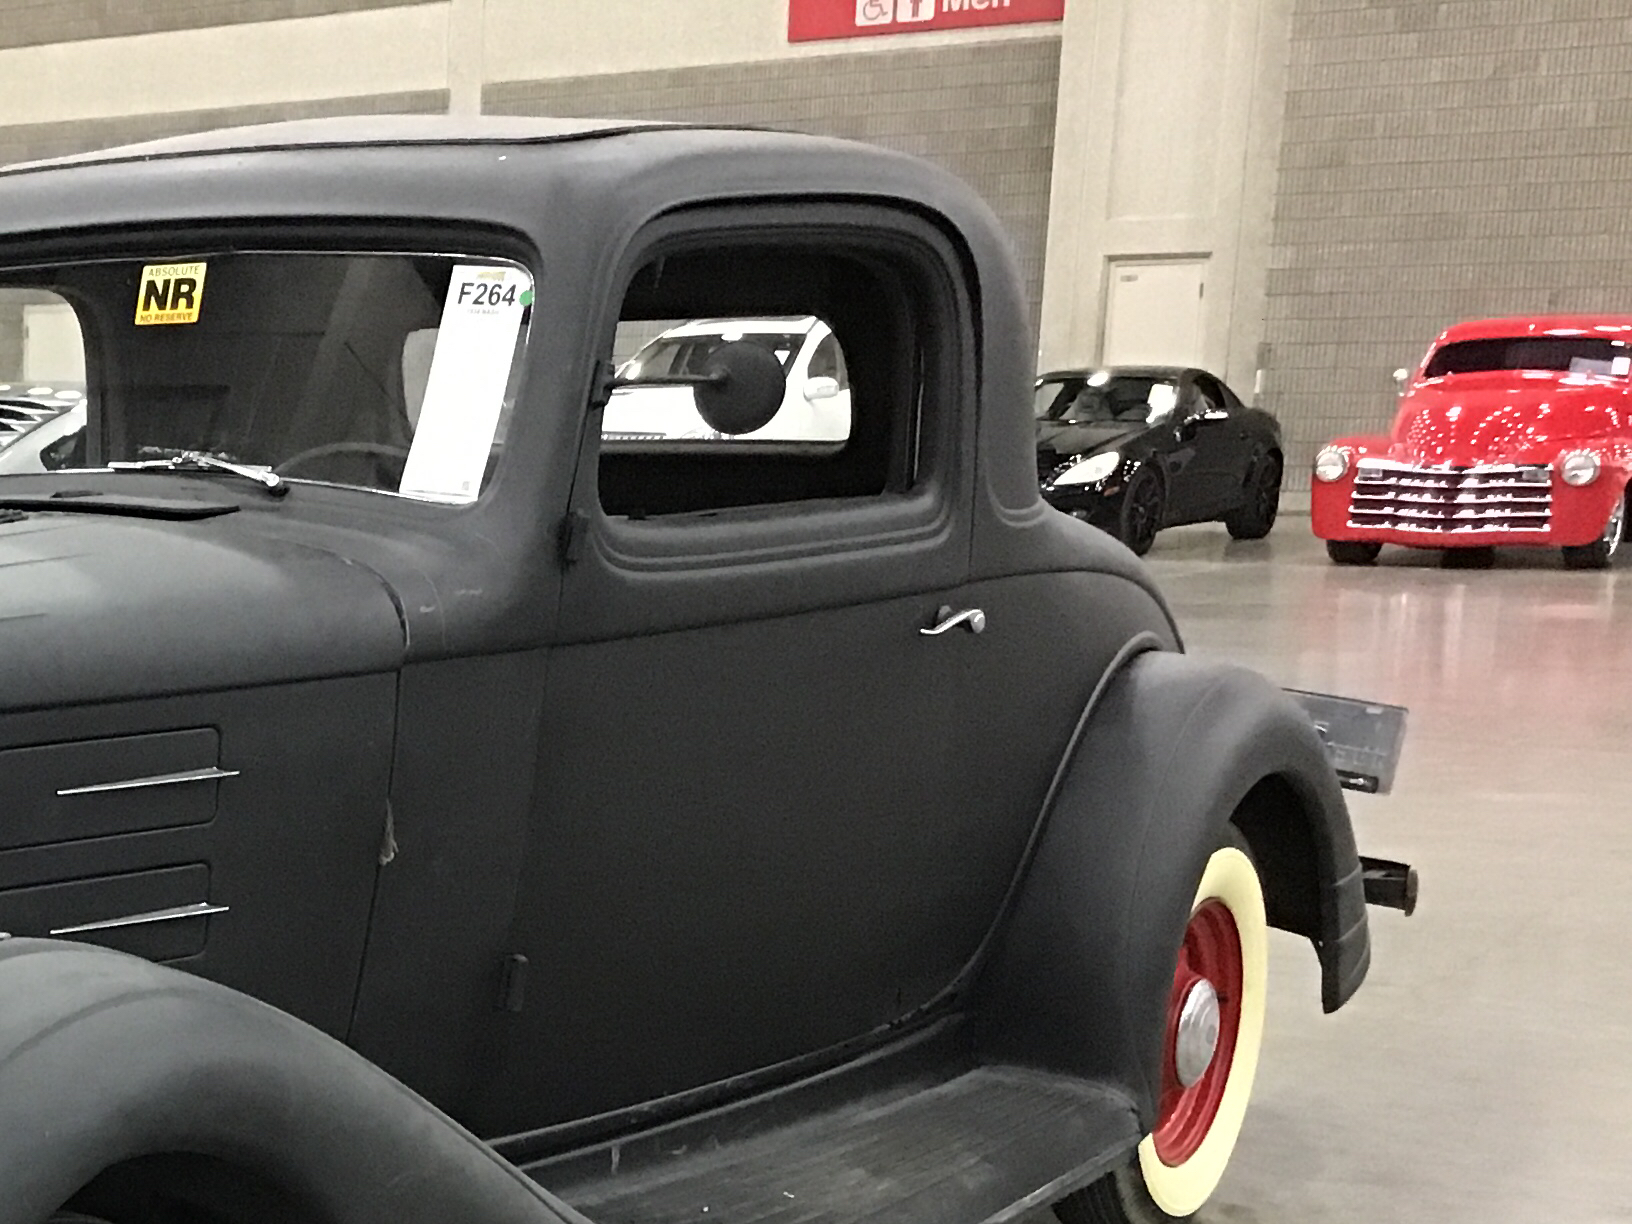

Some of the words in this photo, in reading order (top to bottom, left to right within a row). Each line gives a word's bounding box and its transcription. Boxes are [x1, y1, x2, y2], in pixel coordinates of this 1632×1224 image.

[148, 264, 201, 277] ABSOLUTE
[141, 277, 197, 312] NR
[457, 282, 517, 307] F264
[139, 314, 153, 323] NO
[154, 312, 194, 322] RESERVE
